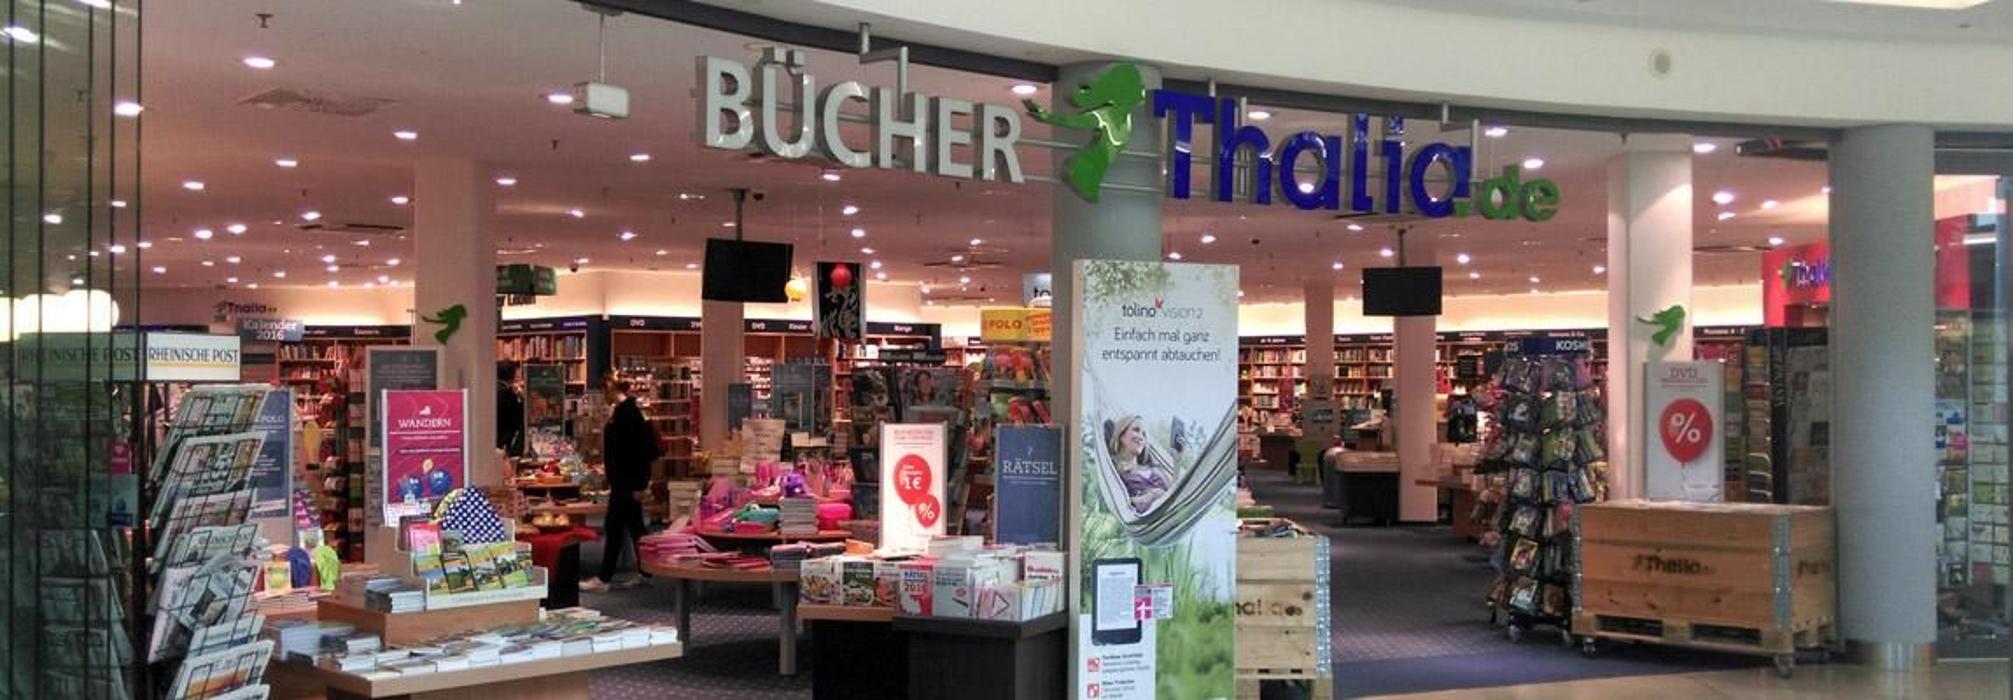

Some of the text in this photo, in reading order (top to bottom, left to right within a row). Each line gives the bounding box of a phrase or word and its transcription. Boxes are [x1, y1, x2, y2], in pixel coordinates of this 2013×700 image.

[698, 47, 1024, 183] BÜCHER
[1121, 303, 1156, 318] tolino
[256, 330, 286, 341] 2016
[1113, 327, 1210, 345] Einfach mal ganz
[149, 349, 239, 363] RHEINISCHE POST
[1102, 348, 1220, 363] entspannt abtauchen!
[398, 418, 451, 429] WANDERN
[1002, 458, 1058, 475] RÄTSEL
